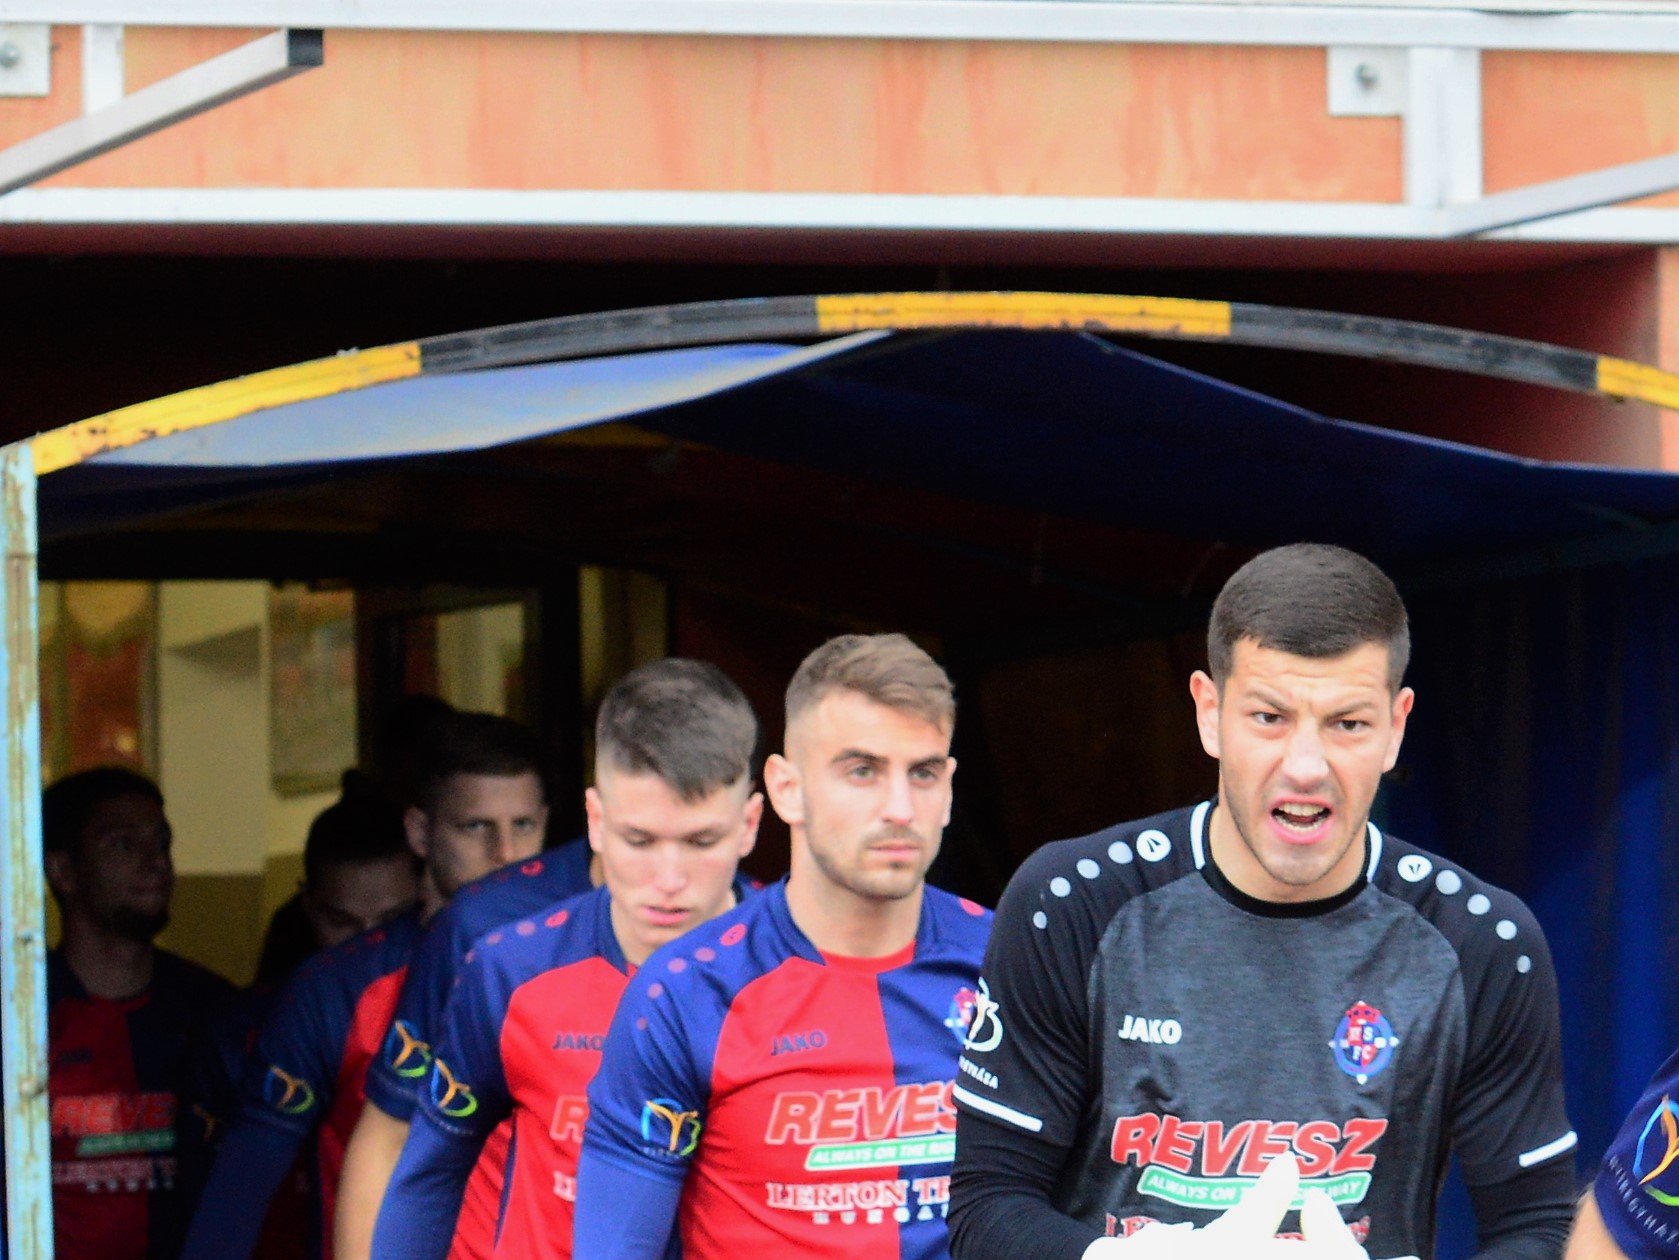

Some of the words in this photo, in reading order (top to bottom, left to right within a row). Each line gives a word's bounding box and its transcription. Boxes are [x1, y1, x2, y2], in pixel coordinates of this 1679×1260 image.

[771, 1029, 827, 1056] JAKO
[1118, 1014, 1182, 1045] JAKO
[812, 1147, 871, 1163] ALWAYS
[874, 1146, 897, 1160] ON
[1110, 1112, 1388, 1177] REVESZ
[766, 1179, 909, 1211] LERTON
[1147, 1174, 1210, 1199] ALWAYS
[1211, 1186, 1237, 1201] ON
